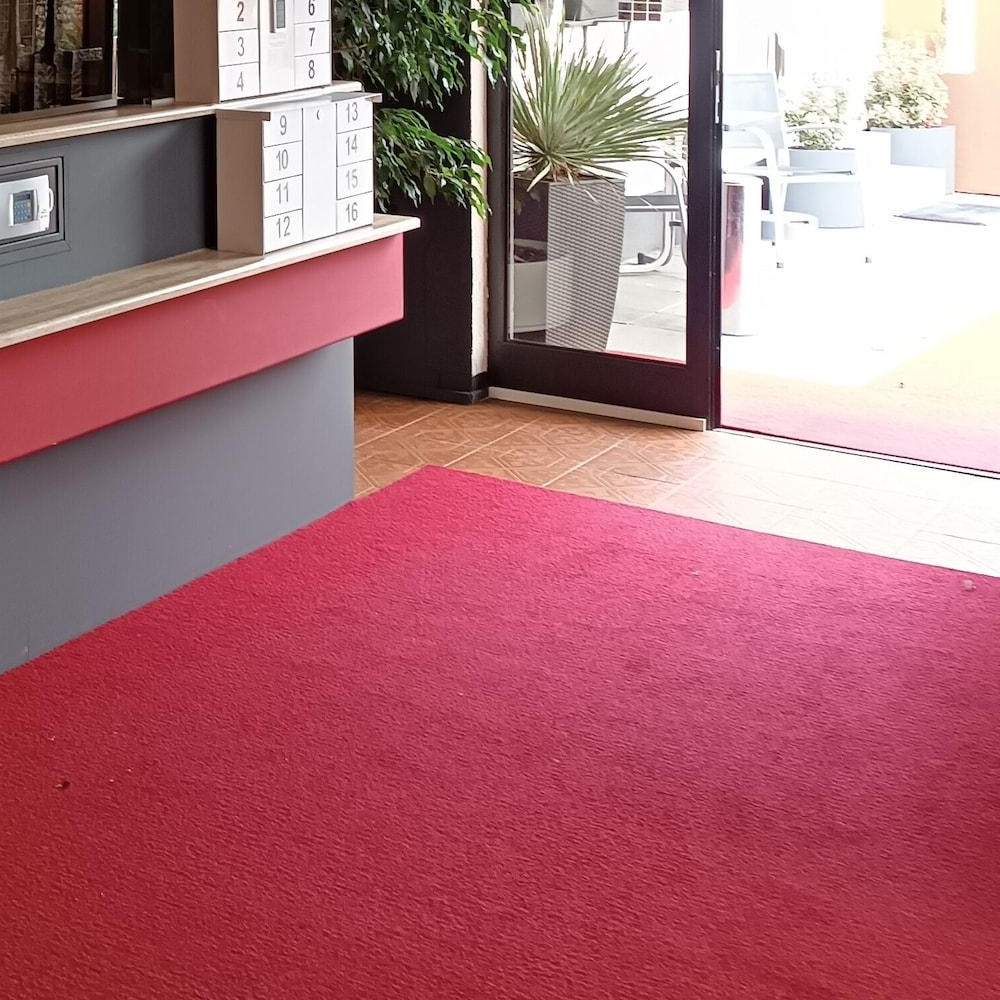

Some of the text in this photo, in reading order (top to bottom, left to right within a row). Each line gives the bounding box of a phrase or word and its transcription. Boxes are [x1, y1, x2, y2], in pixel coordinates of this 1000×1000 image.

[237, 1, 245, 22] 2
[237, 36, 245, 57] 3
[308, 27, 315, 47] 7
[308, 59, 315, 79] 8
[236, 71, 244, 92] 4
[345, 101, 359, 123] 13
[280, 114, 287, 135] 9
[345, 133, 358, 156] 14
[276, 149, 288, 171] 10
[345, 168, 359, 191] 15
[276, 181, 289, 205] 11
[345, 202, 359, 223] 16
[276, 215, 291, 239] 12
